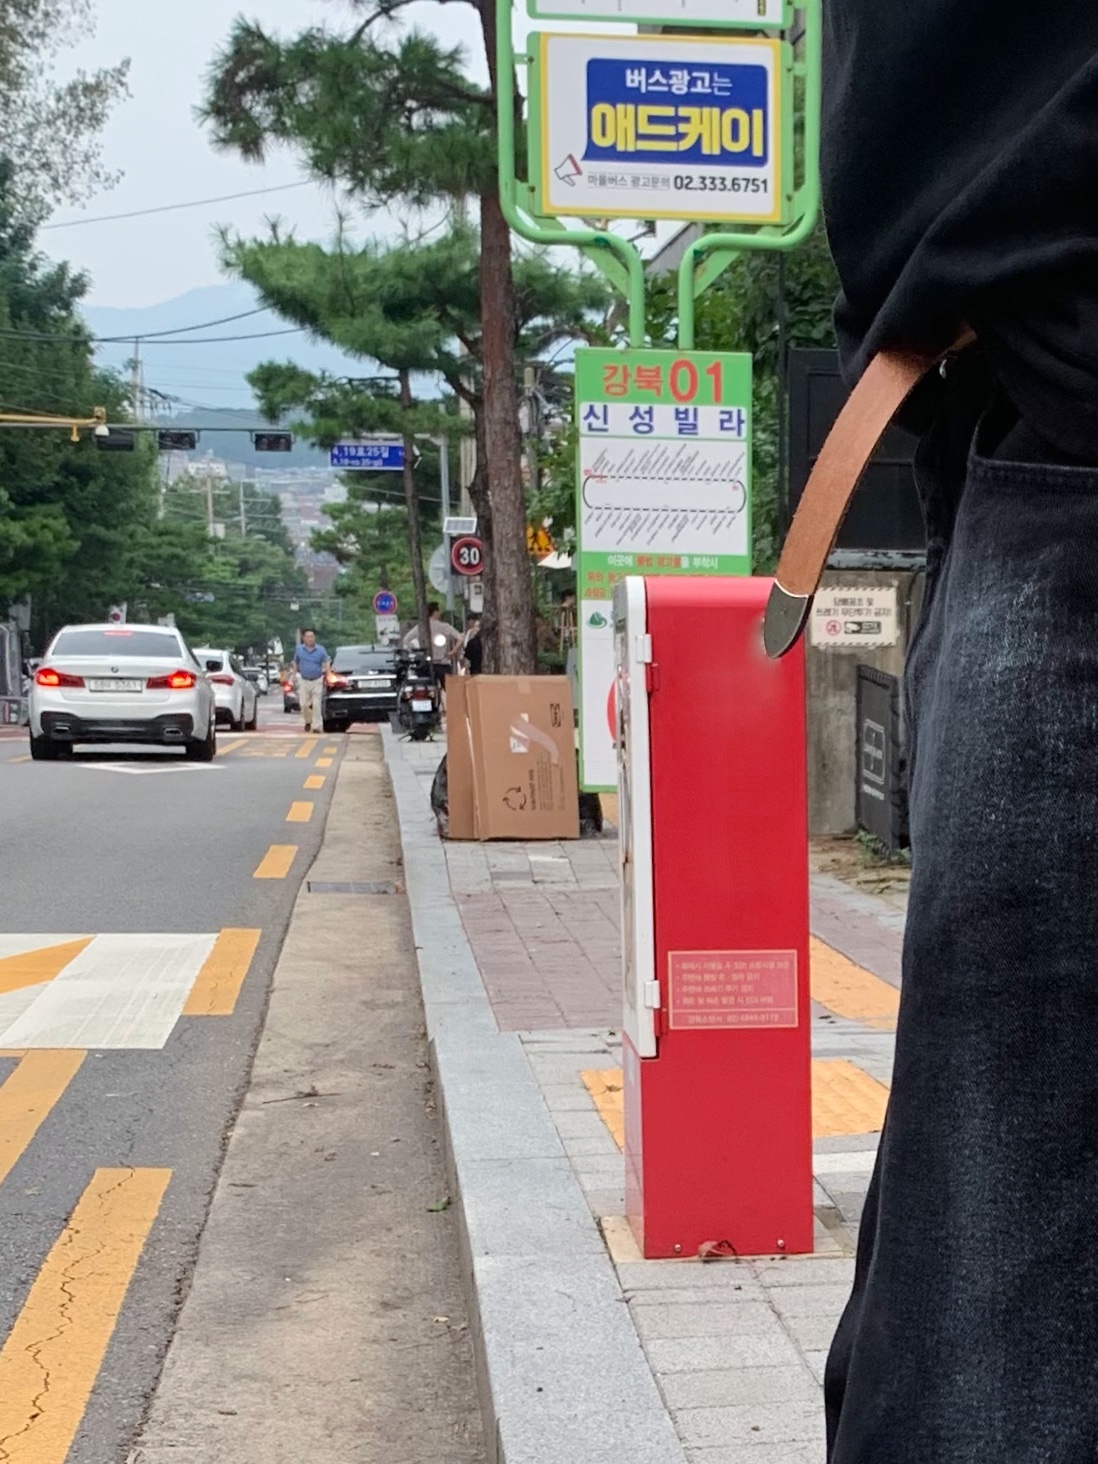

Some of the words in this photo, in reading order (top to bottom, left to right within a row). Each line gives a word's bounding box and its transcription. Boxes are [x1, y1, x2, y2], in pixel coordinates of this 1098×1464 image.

[625, 67, 733, 96] 버스광고는
[591, 103, 764, 157] 애드케이
[673, 175, 768, 193] 02.333.6751
[460, 547, 480, 565] 30
